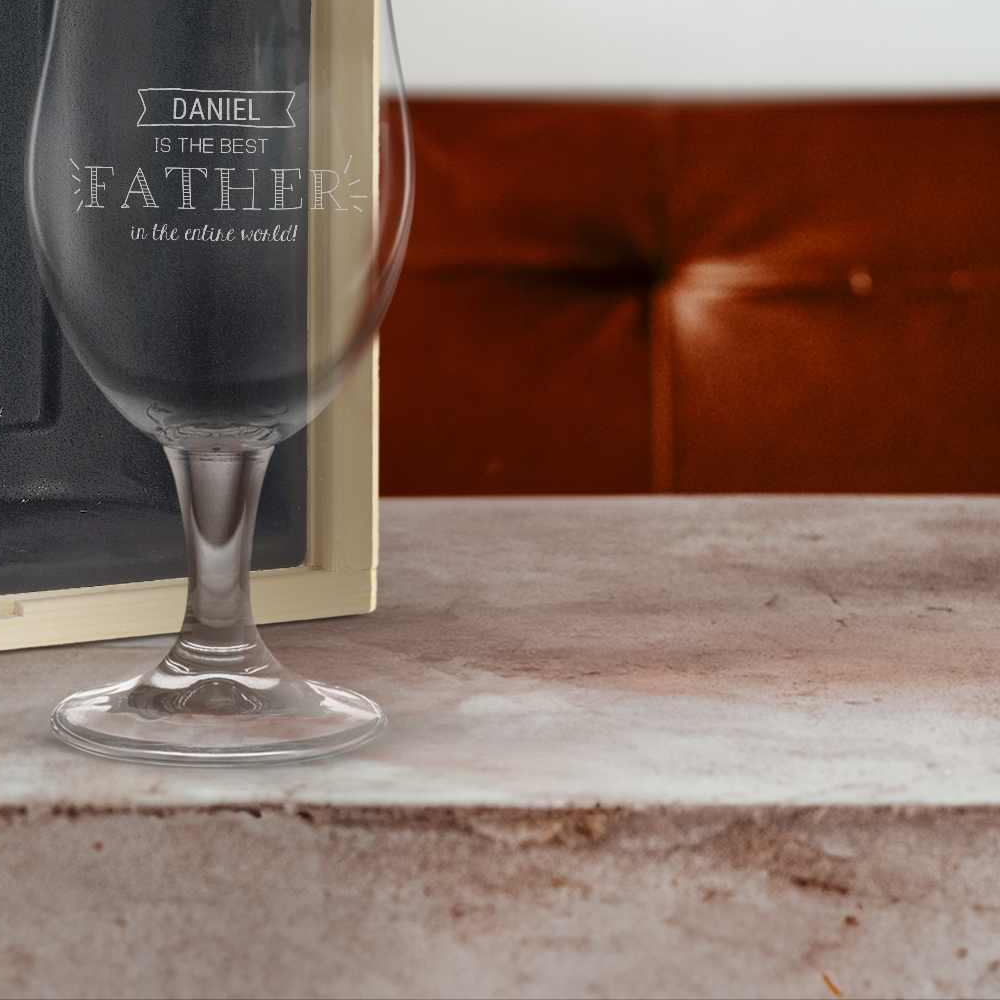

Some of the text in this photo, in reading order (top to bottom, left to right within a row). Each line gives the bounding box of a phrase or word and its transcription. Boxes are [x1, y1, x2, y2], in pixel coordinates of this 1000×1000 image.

[172, 97, 260, 121] DANIEL
[154, 137, 268, 154] IS THE BEST
[84, 165, 349, 211] FATHER
[131, 223, 298, 242] in the entire world!
